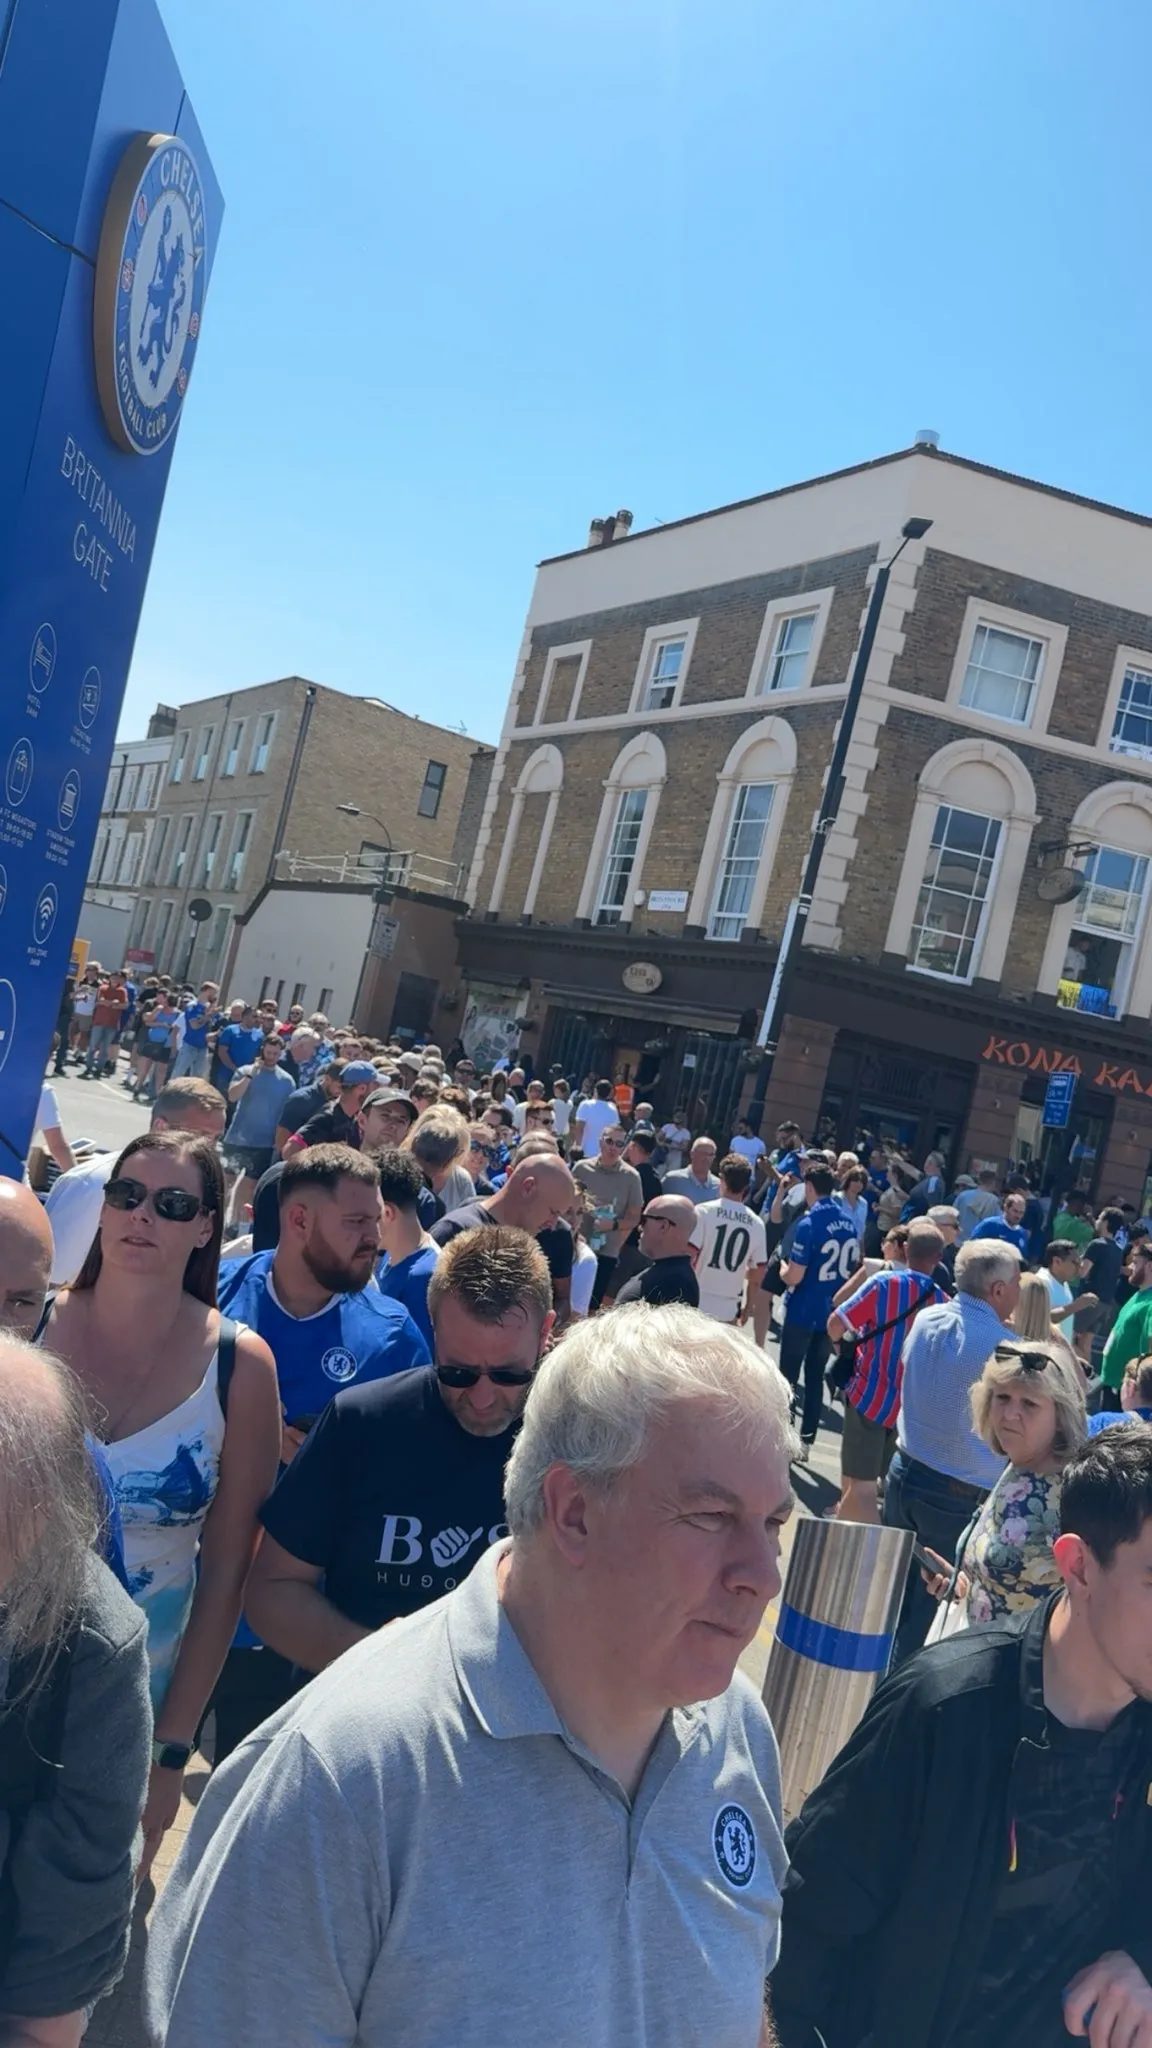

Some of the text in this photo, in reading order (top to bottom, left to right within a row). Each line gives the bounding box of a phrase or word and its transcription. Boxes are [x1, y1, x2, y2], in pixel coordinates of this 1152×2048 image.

[160, 150, 205, 270] CHELSEA
[119, 341, 167, 439] FOOTBALL CLUB
[61, 434, 137, 563] BRITANNIA
[73, 522, 113, 592] GATE
[981, 1035, 1082, 1078] KONA
[717, 1207, 753, 1226] PALMER
[708, 1224, 750, 1272] 10
[818, 1238, 859, 1281] 20
[377, 1571, 457, 1590] HUGO
